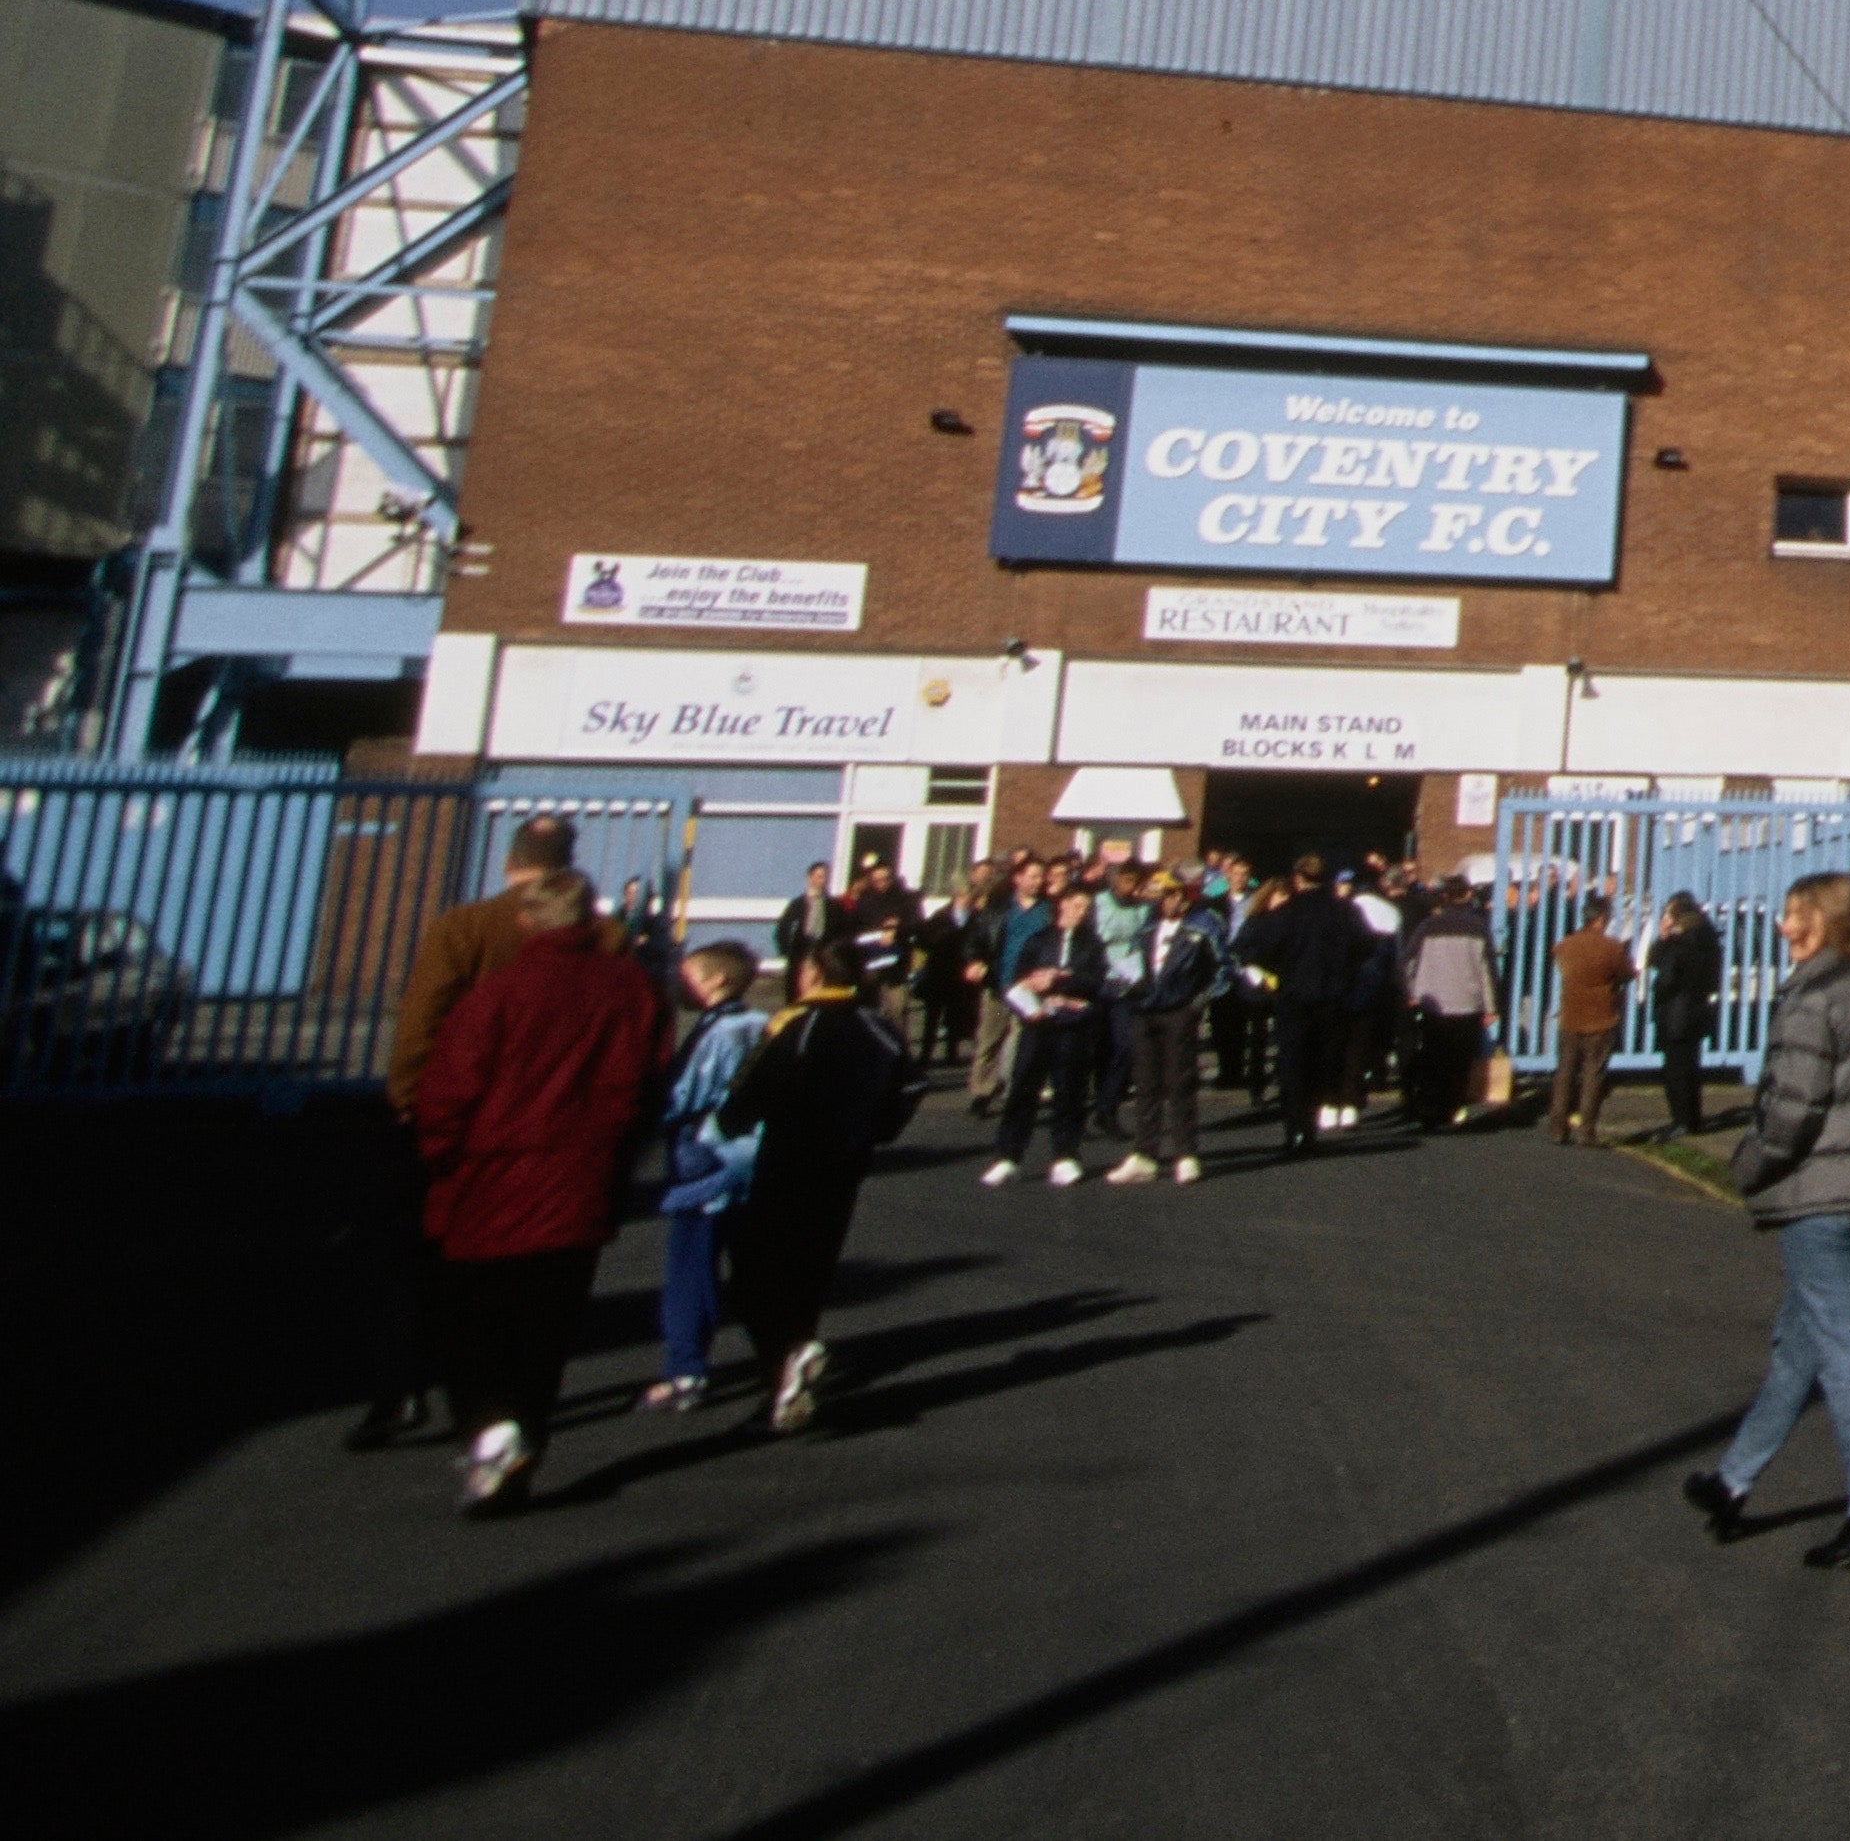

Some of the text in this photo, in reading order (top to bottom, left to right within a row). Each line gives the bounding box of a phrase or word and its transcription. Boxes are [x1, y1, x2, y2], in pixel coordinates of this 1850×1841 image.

[1284, 394, 1481, 432] Welcome to
[1145, 426, 1599, 498] COVENTRY
[1198, 492, 1552, 558] CITY F.C.
[647, 563, 691, 580] Join
[698, 564, 731, 581] the
[728, 588, 761, 605] the
[767, 588, 849, 607] benefits
[1159, 606, 1349, 637] RESTAURANT
[582, 699, 895, 745] Sky Blue Travel
[1240, 714, 1403, 734] MAIN STAND
[1222, 739, 1415, 759] BLOCKS K L M
